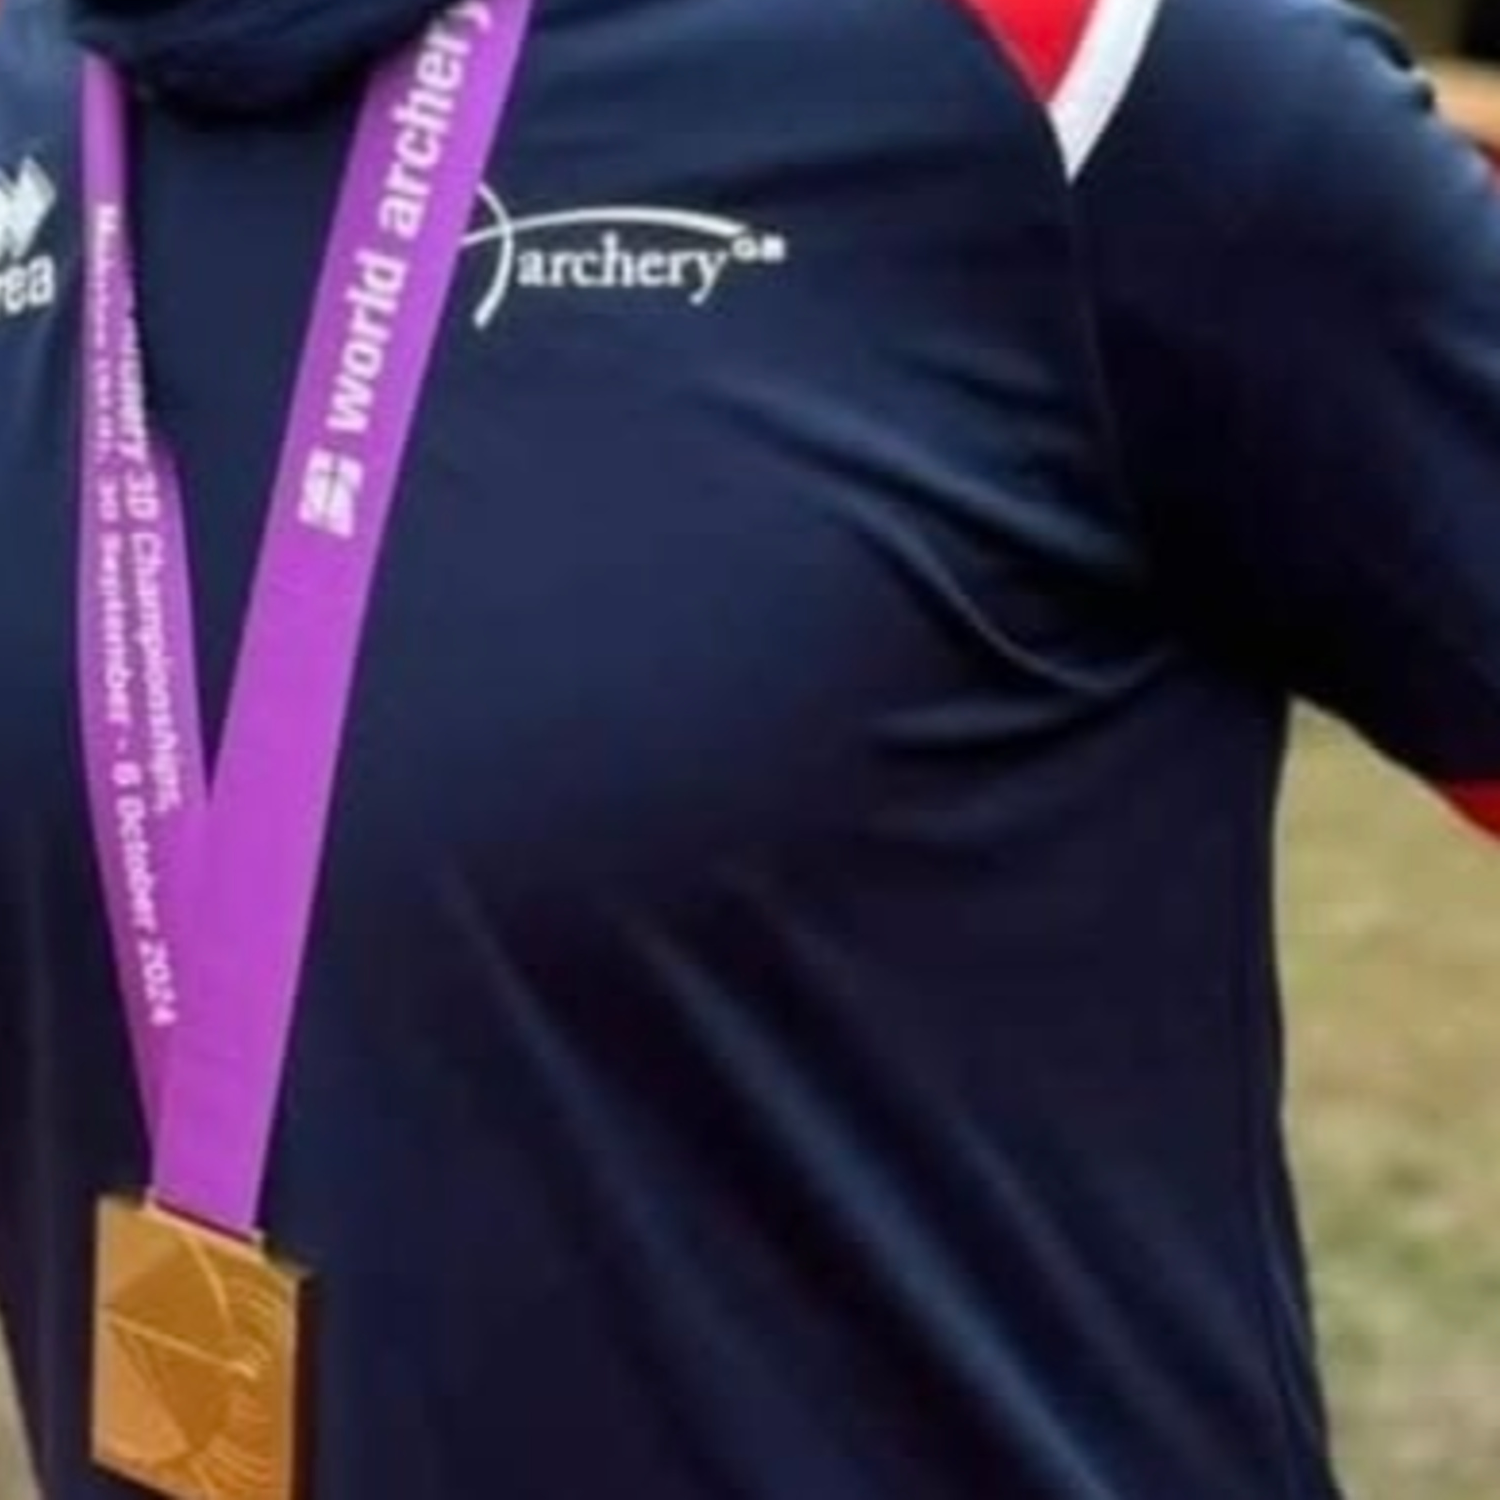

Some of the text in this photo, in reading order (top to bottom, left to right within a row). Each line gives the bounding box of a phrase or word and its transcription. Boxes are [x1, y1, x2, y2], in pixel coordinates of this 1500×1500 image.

[517, 232, 729, 304] archery
[325, 250, 409, 433] world
[124, 467, 160, 520] 3D
[115, 796, 157, 932] October
[138, 939, 177, 1027] 2024
